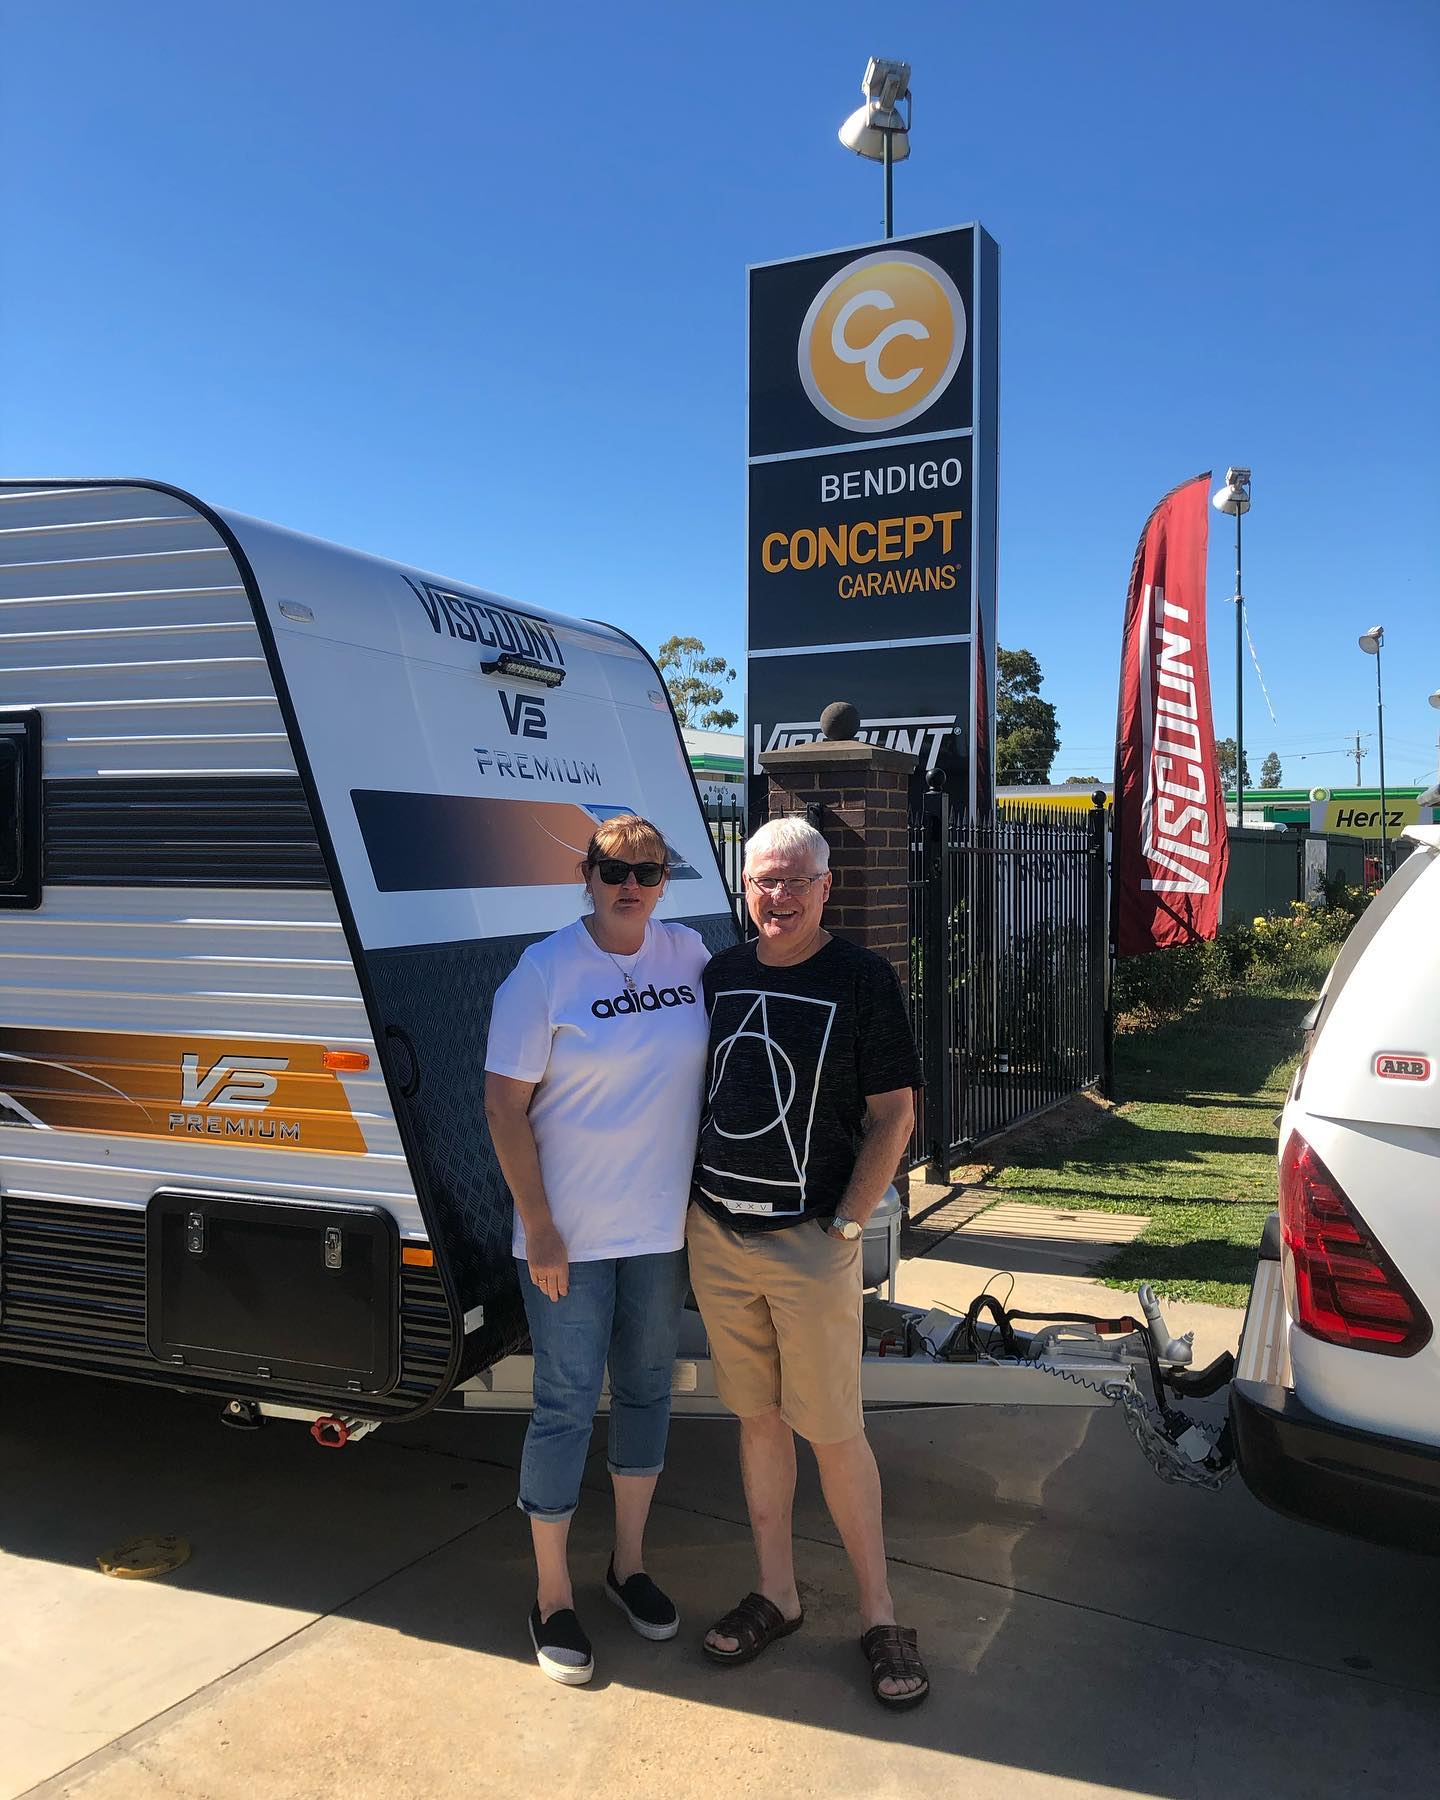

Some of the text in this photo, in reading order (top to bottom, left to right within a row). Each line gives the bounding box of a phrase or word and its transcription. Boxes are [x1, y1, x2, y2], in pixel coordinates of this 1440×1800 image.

[821, 458, 962, 503] BENDIGO
[762, 511, 962, 574] CONCEPT
[400, 574, 565, 665] VISCOUNT
[498, 689, 548, 740] V2
[1139, 583, 1210, 895] VISCOUNT
[473, 747, 602, 787] PREMIUM
[591, 983, 697, 1019] adidas
[180, 1053, 290, 1112] V2
[1382, 1060, 1424, 1076] ARB
[168, 1113, 300, 1142] PREMIUM
